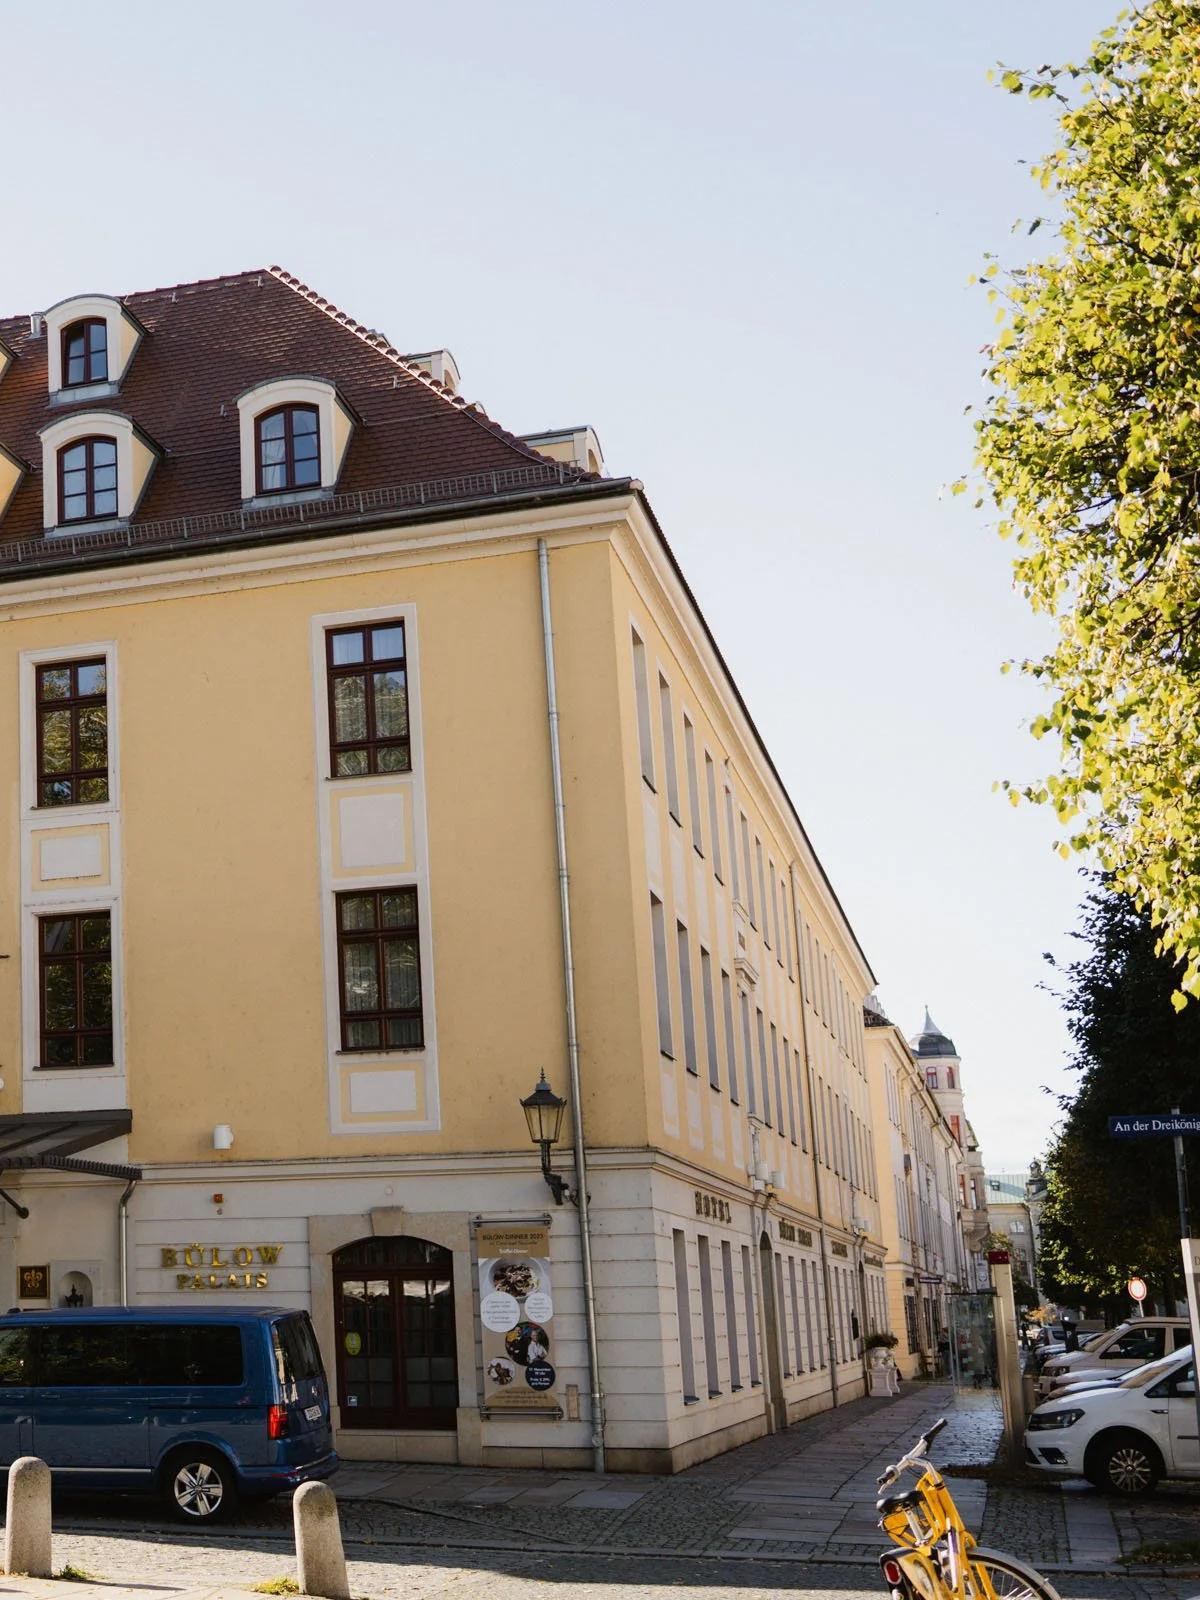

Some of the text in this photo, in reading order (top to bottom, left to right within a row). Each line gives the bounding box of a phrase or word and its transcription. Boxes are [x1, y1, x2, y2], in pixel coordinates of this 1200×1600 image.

[1114, 1121, 1131, 1132] An
[1132, 1120, 1149, 1131] der
[695, 1191, 732, 1225] HOTEL
[160, 1243, 284, 1268] BÜLOW
[176, 1272, 269, 1290] PALAIS
